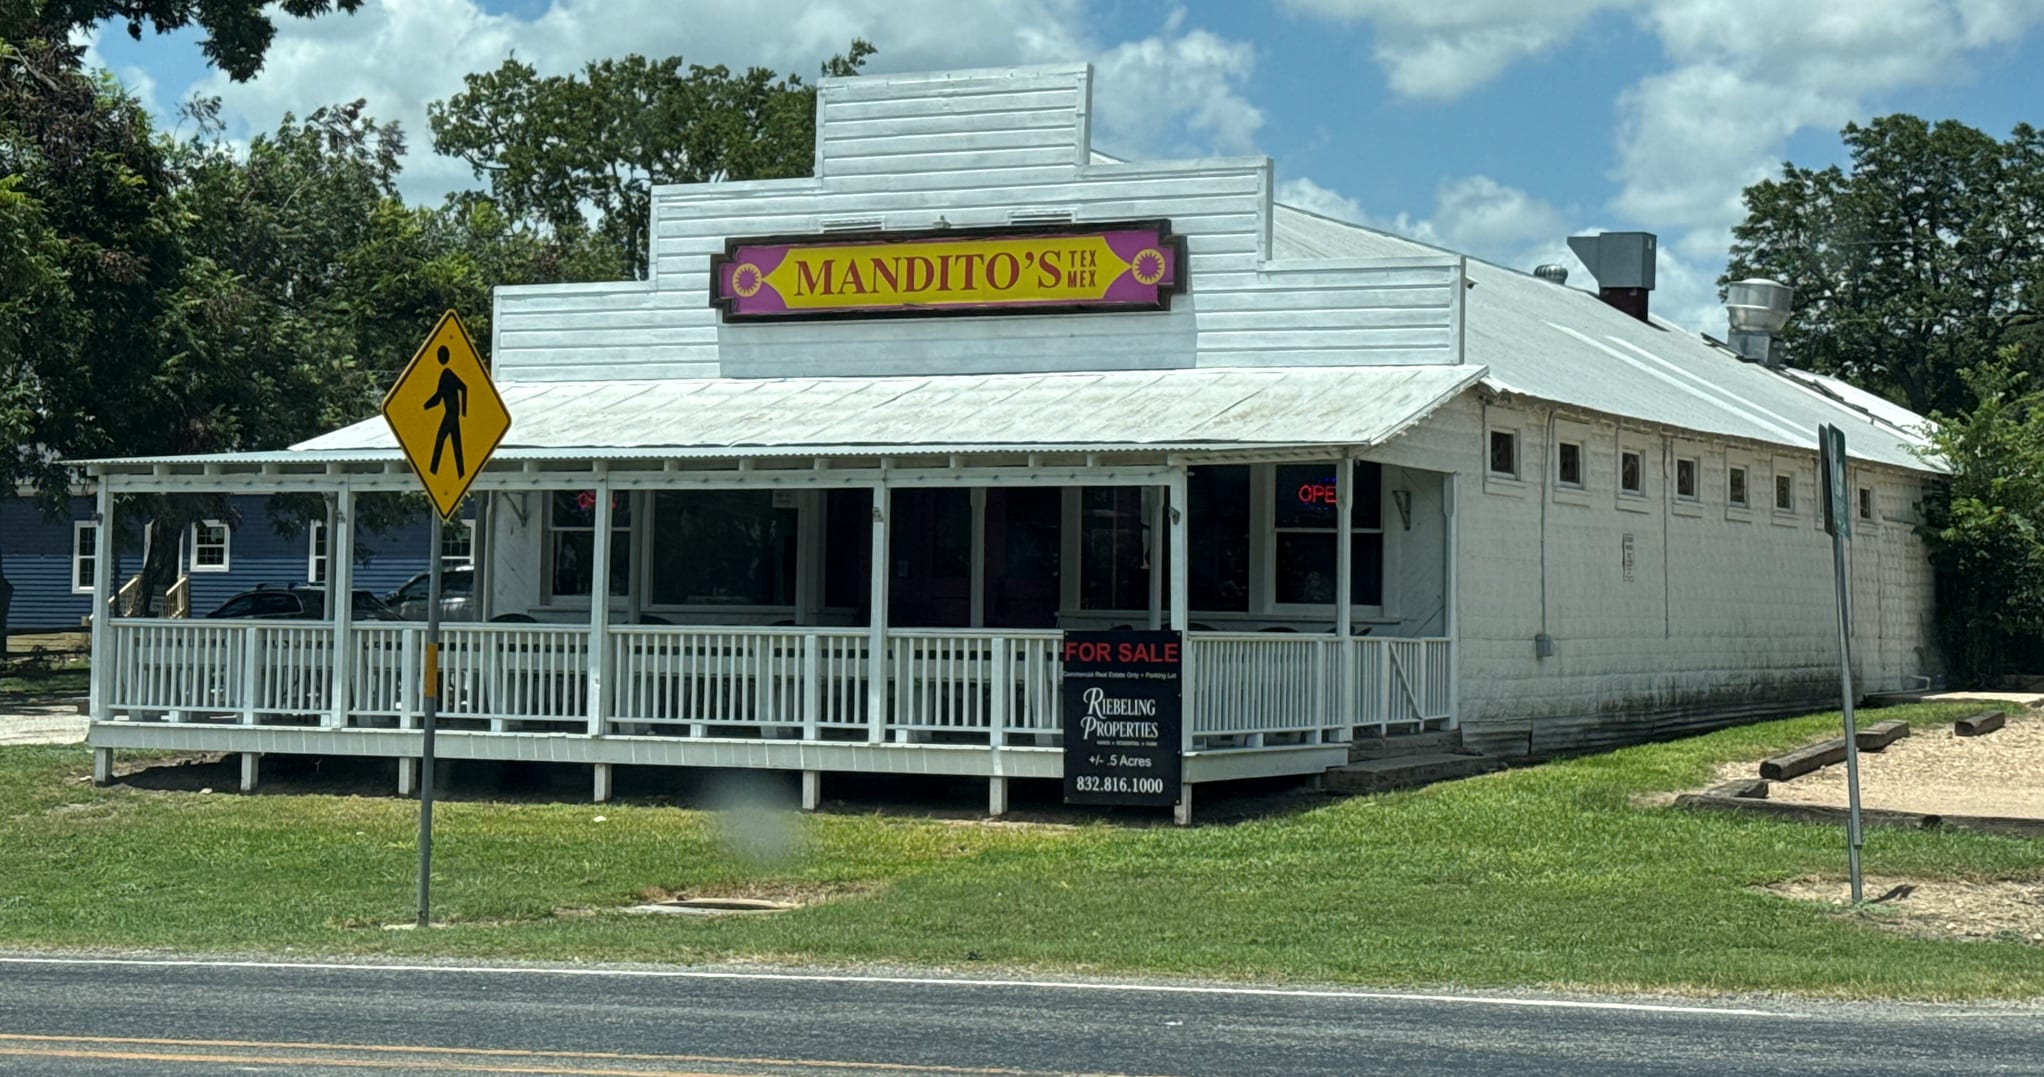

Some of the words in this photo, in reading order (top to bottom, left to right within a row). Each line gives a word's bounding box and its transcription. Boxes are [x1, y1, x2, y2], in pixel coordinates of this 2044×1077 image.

[1069, 249, 1097, 268] TEX
[795, 250, 1061, 296] MANDITO'S
[1067, 269, 1097, 288] MEX
[1298, 484, 1337, 503] OPE
[1065, 642, 1112, 662] FOR
[1118, 643, 1179, 663] SALE
[1108, 671, 1126, 679] Estate
[1127, 672, 1139, 680] Only
[1145, 672, 1166, 680] Parking
[1080, 716, 1159, 740] PROPERTIES
[1089, 754, 1104, 766] +/-
[1107, 754, 1118, 767] .5
[1119, 754, 1152, 767] Acres
[1076, 776, 1164, 793] 832.816.1000
